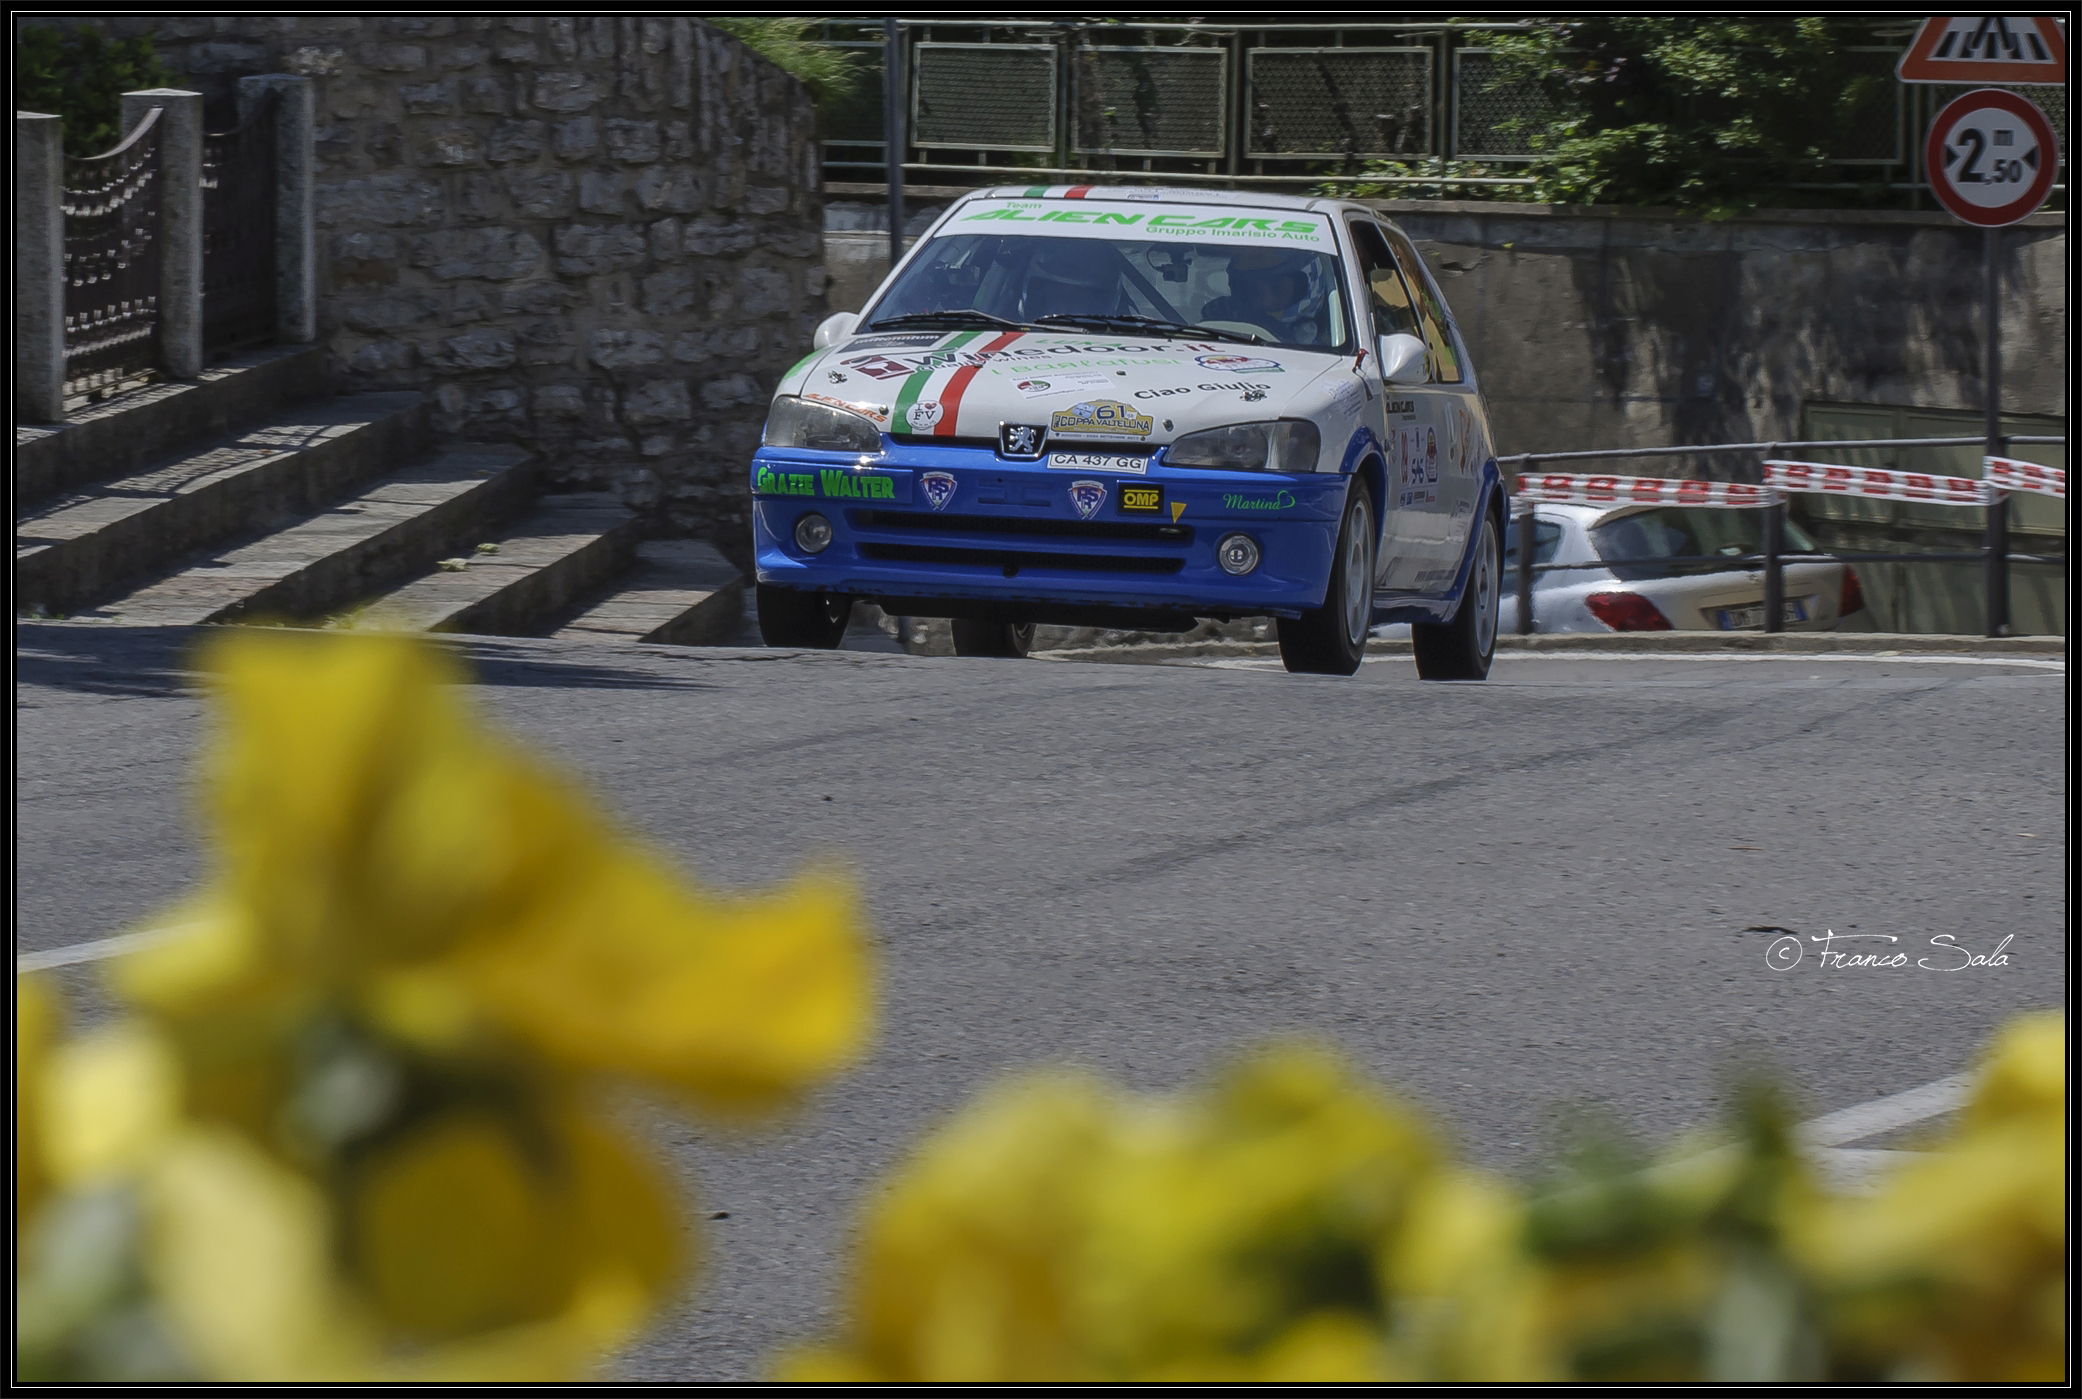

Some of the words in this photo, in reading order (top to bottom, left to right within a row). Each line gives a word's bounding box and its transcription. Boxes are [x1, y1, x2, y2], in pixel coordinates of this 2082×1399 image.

[1006, 201, 1042, 209] Team
[959, 209, 1145, 225] ALIEN
[1148, 215, 1319, 233] CARS
[1146, 226, 1206, 237] Gruppo
[1211, 228, 1277, 239] Imarisio
[1281, 232, 1320, 242] Auto
[1134, 386, 1191, 400] Ciao
[1197, 382, 1272, 392] Giulio
[913, 410, 936, 420] FV
[1096, 405, 1126, 419] 61
[1060, 416, 1095, 428] COPPA
[1054, 454, 1078, 464] CA
[1083, 455, 1112, 466] 437
[1116, 457, 1142, 469] GG
[1124, 493, 1159, 506] OMP
[1222, 493, 1282, 510] Martina
